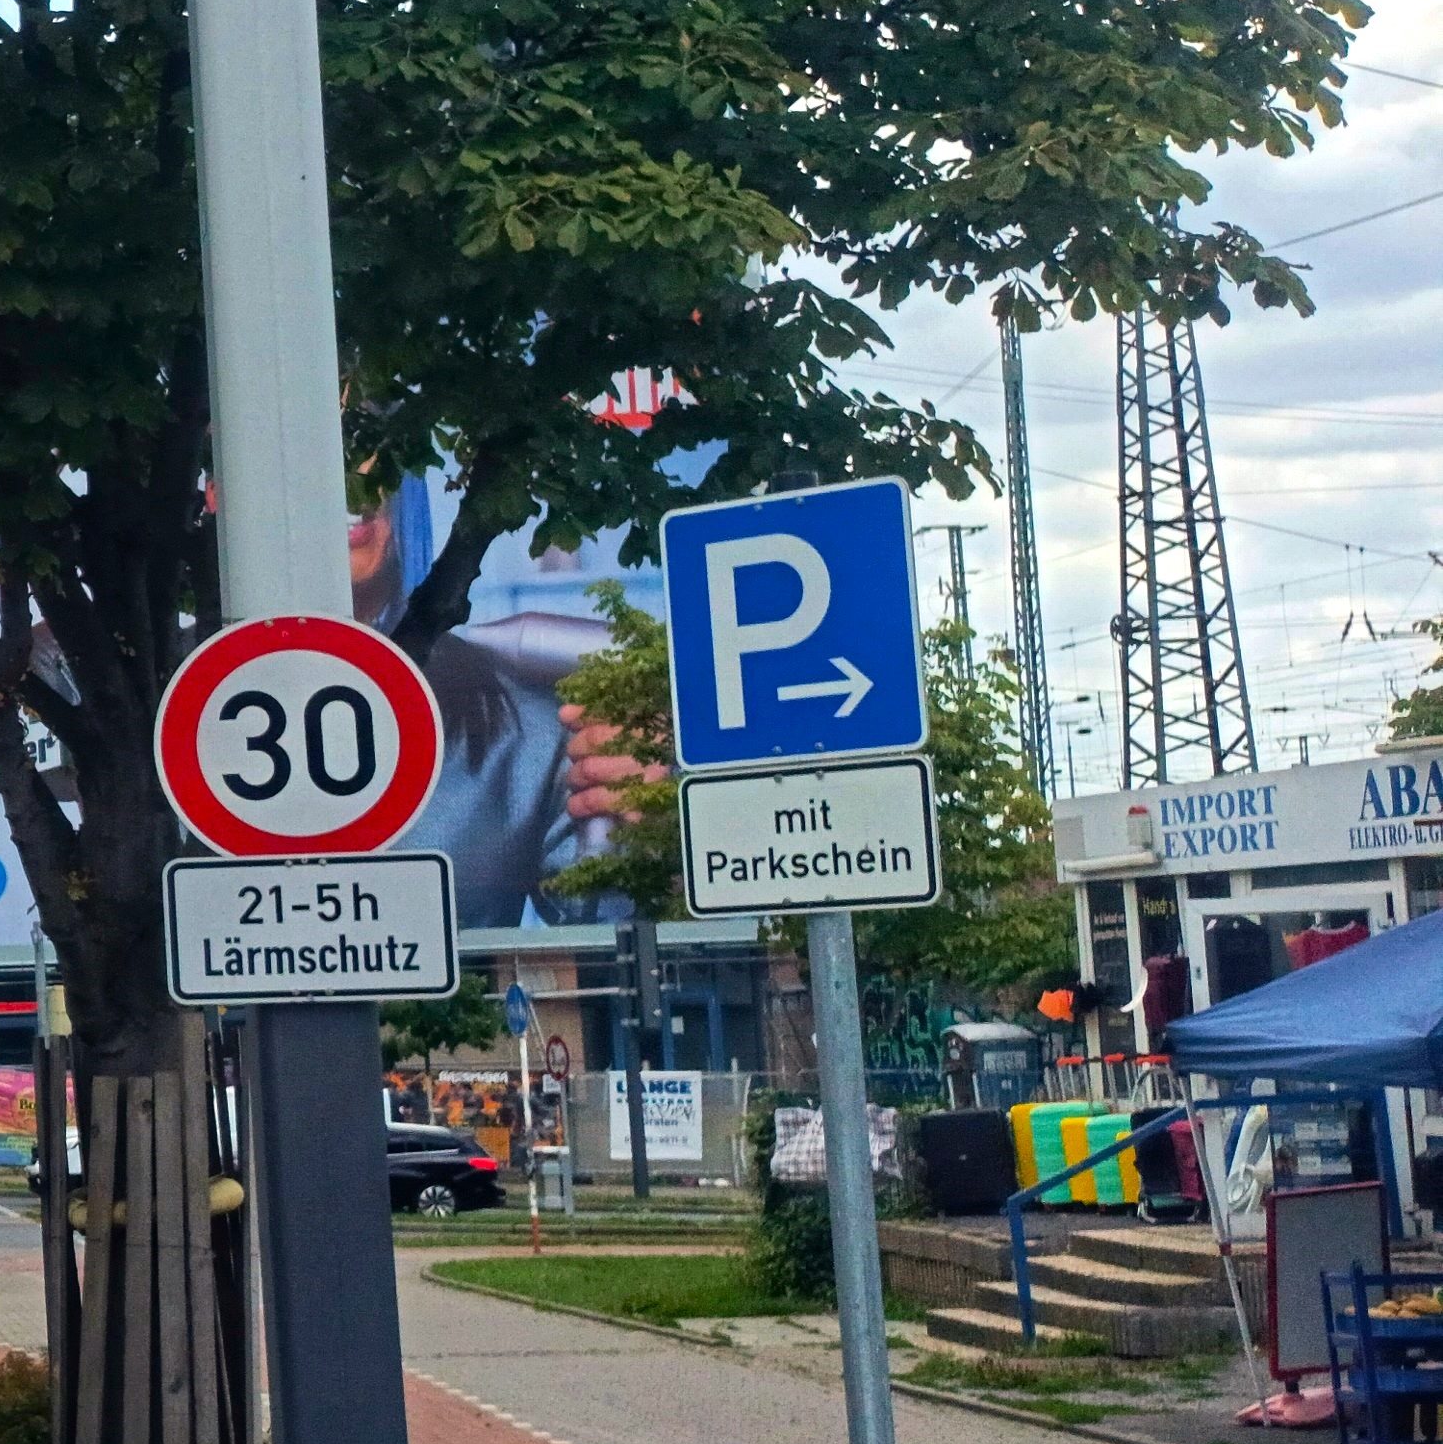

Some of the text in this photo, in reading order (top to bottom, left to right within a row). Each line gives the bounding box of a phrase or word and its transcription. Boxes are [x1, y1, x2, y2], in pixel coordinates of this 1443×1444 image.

[218, 684, 377, 801] 30
[774, 798, 832, 835] mit
[1159, 785, 1278, 827] IMPORT
[1163, 820, 1279, 859] EXPORT
[706, 839, 912, 884] Parkschein
[237, 881, 379, 926] 21-5 h
[203, 933, 420, 977] Lärmschutz
[616, 1080, 692, 1095] LNGE
